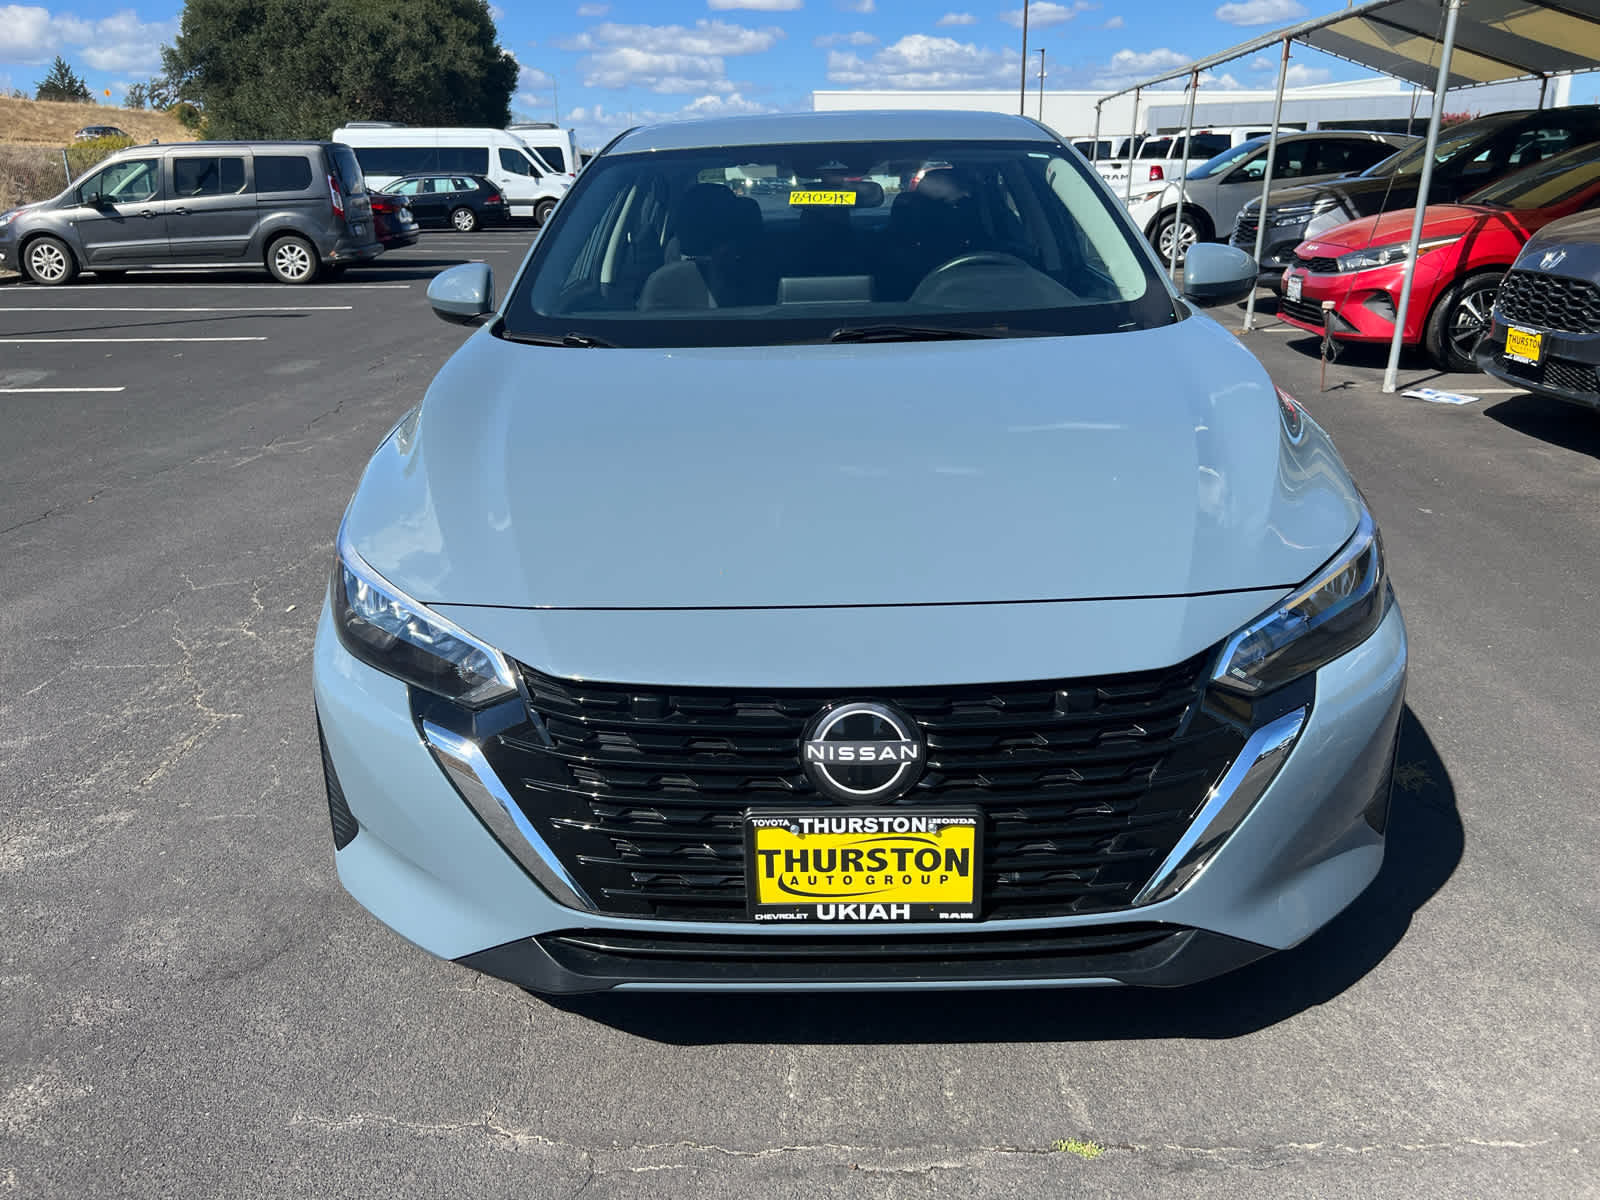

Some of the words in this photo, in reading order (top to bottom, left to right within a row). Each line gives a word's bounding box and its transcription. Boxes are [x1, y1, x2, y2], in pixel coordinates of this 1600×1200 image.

[807, 744, 918, 761] NISSAN
[752, 818, 791, 827] TOYOTA
[799, 817, 927, 833] THURSTON
[931, 817, 977, 825] HONDA
[758, 847, 969, 878] THURSTON
[790, 874, 853, 885] AUTO
[865, 874, 950, 885] GROUP
[816, 903, 910, 920] UKIAH
